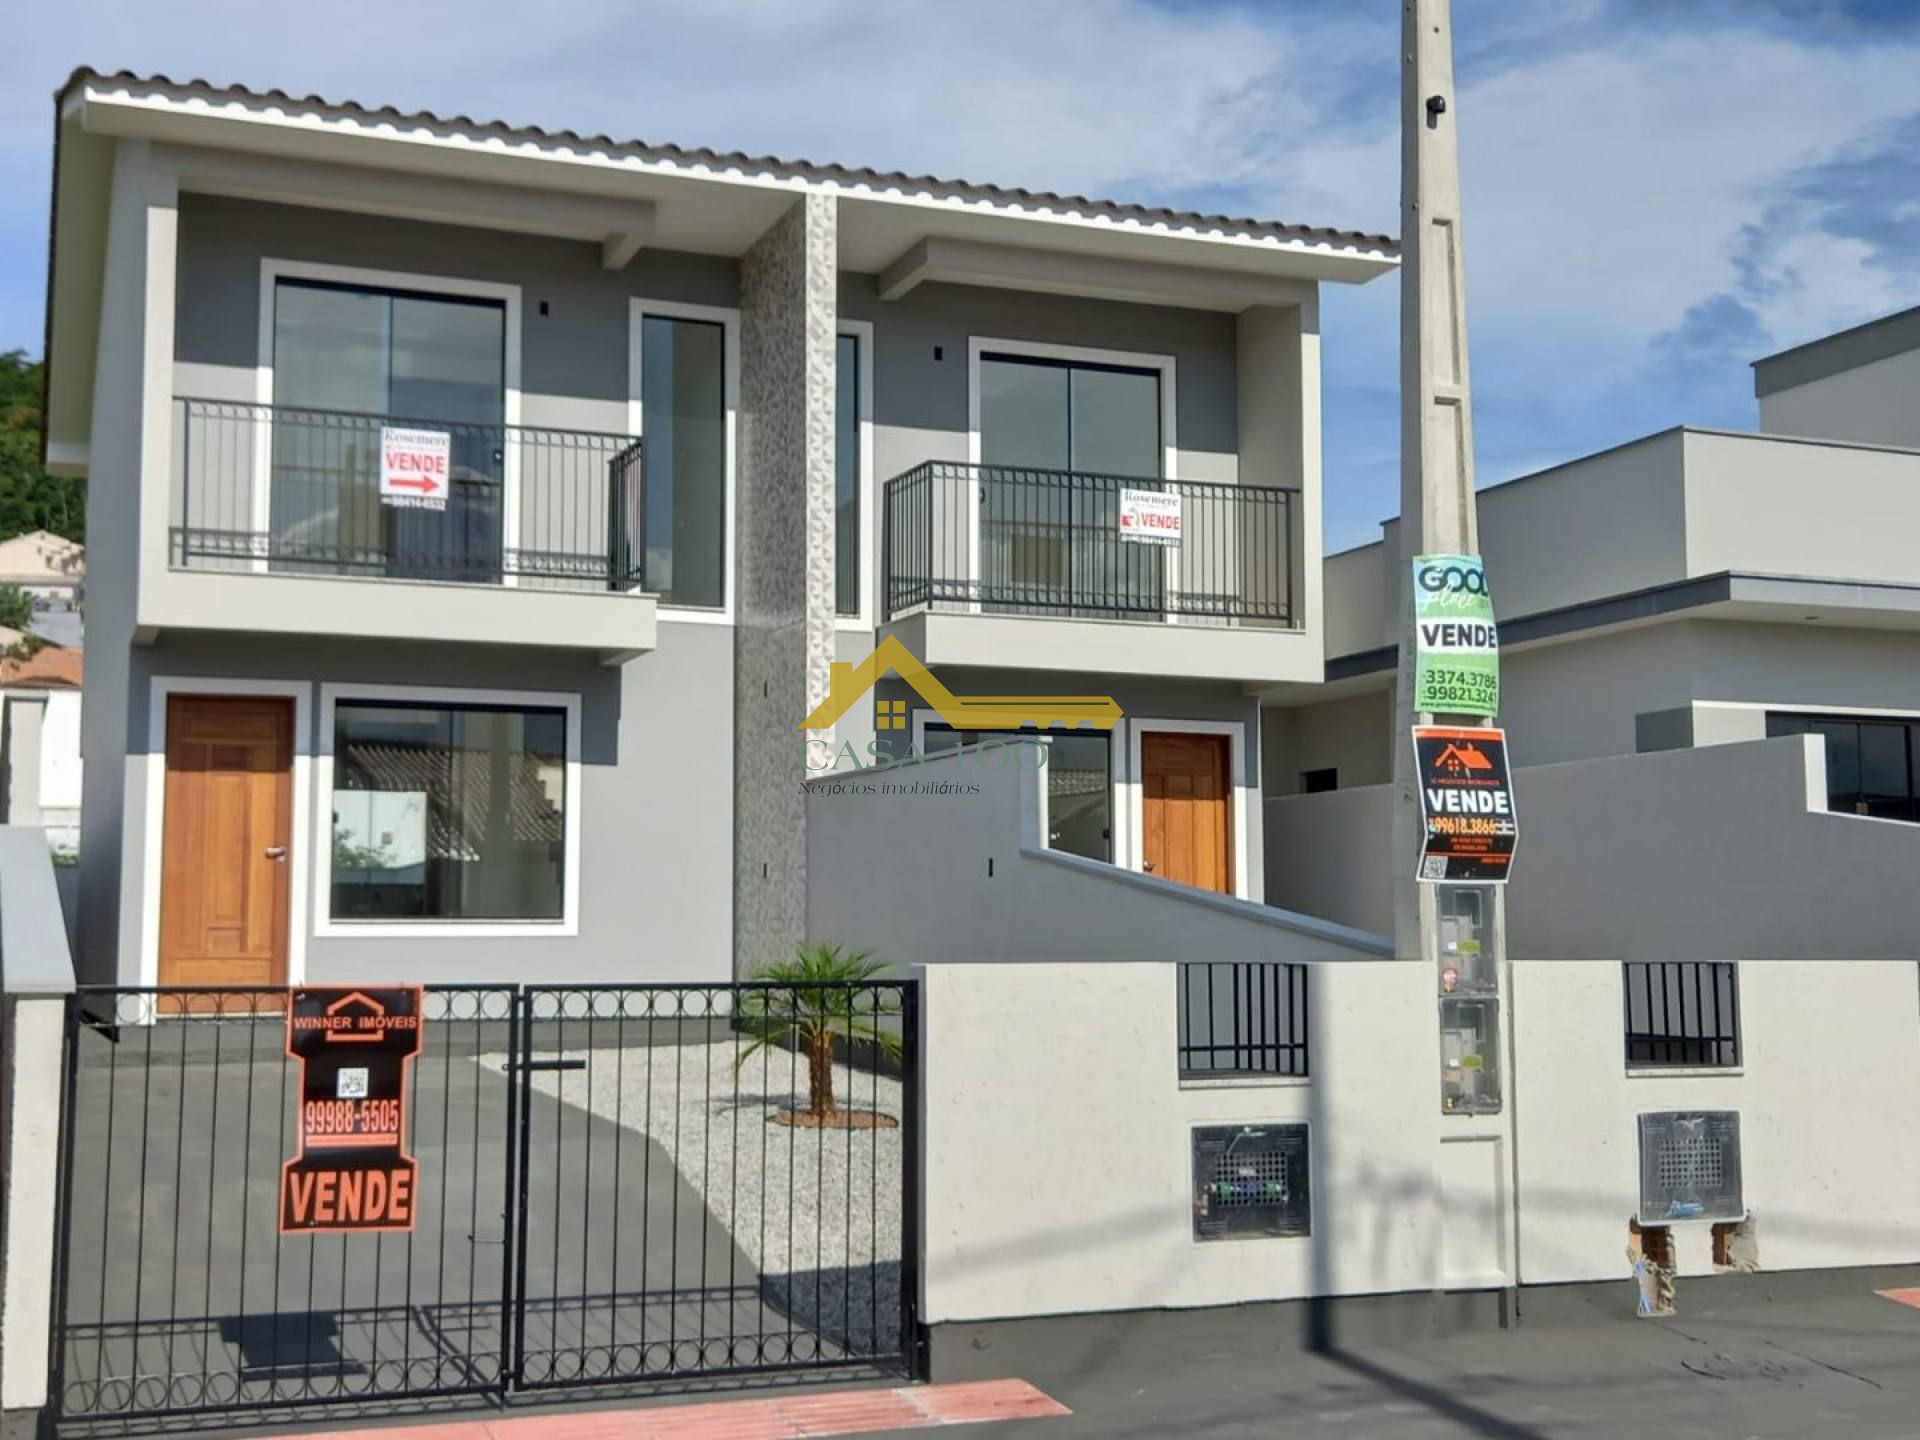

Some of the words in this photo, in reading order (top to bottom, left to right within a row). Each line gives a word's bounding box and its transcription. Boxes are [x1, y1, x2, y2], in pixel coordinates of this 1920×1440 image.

[385, 451, 446, 474] VENDE
[1140, 511, 1180, 530] VENDE
[1420, 623, 1497, 649] VENDE
[1427, 788, 1509, 814] VENDE
[294, 1016, 352, 1029] WINNER
[305, 1100, 399, 1133] 99988-5505
[289, 1169, 410, 1222] VENDE
